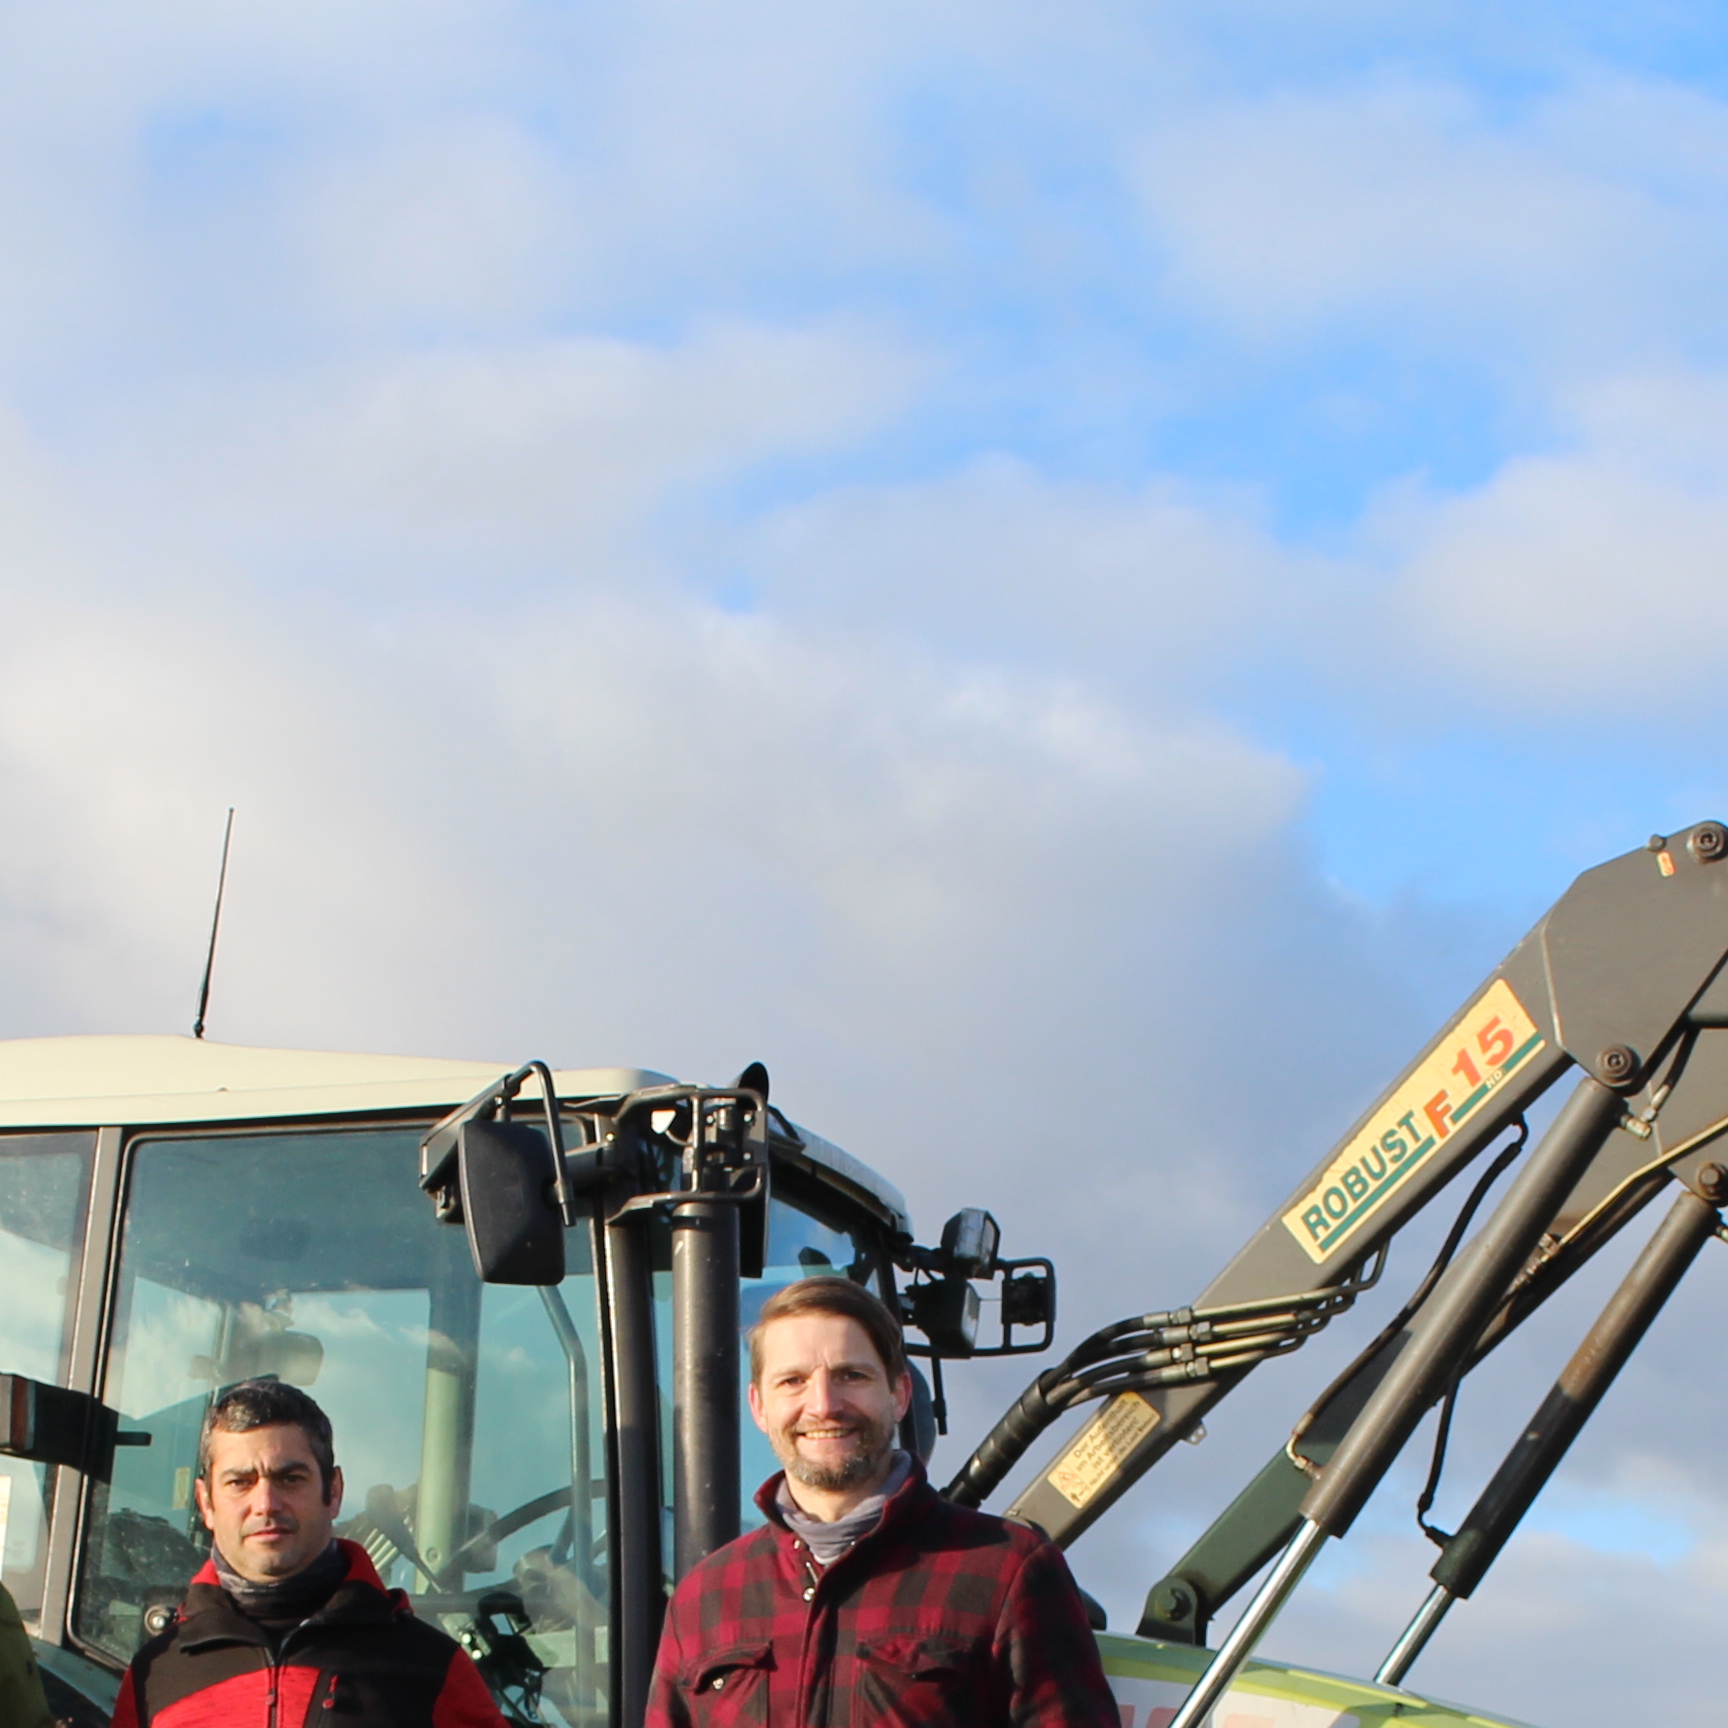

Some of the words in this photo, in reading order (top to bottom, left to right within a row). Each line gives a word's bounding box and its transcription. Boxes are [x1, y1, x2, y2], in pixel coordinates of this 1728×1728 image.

[1301, 1109, 1422, 1243] ROBUST
[1423, 1089, 1452, 1139] F
[1452, 1016, 1515, 1088] 15
